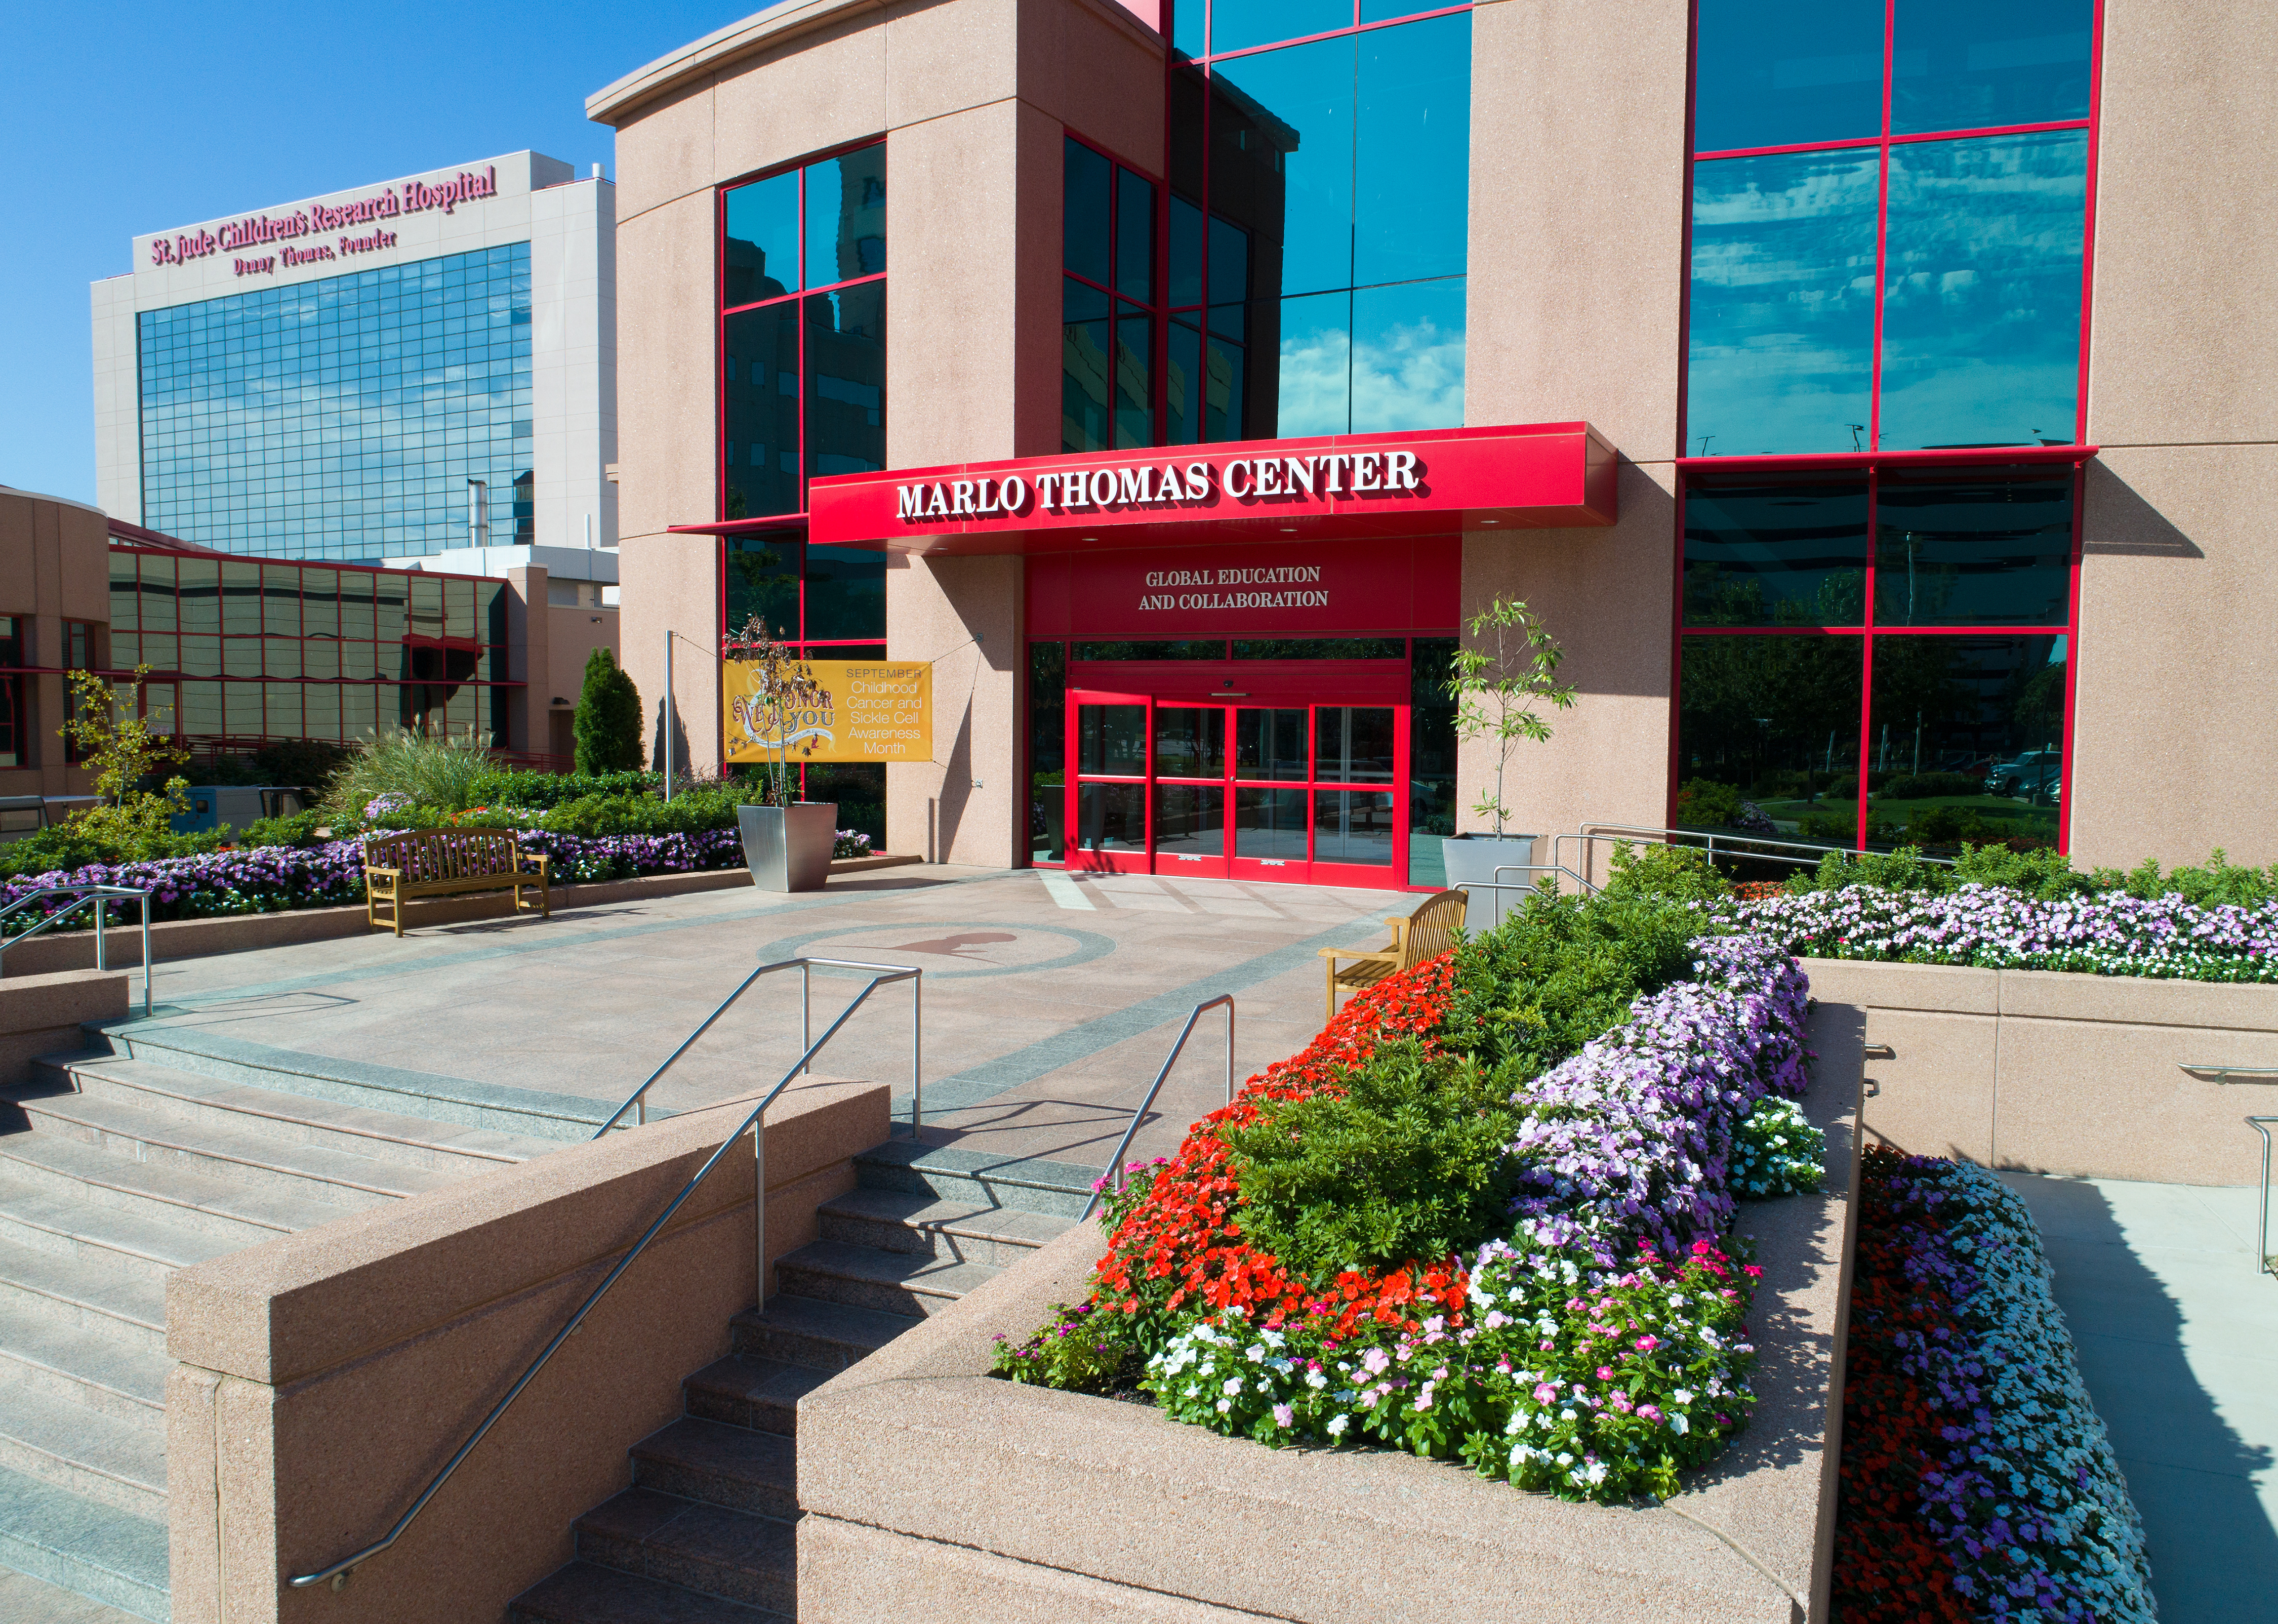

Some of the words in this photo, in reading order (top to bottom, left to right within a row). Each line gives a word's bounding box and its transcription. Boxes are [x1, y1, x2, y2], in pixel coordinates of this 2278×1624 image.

[152, 238, 171, 264] St.
[174, 229, 214, 265] Jude
[216, 210, 307, 250] Children's
[308, 187, 398, 231] Research
[400, 165, 494, 213] Hospital
[233, 256, 274, 275] Danny
[279, 246, 335, 266] Thomas,
[338, 227, 395, 254] Founder
[896, 476, 1026, 518] MARLO
[1036, 462, 1210, 508] THOMAS
[1223, 451, 1419, 498] CENTER
[1146, 570, 1214, 587] GLOBAL
[1217, 566, 1321, 584] EDUCATION
[1138, 595, 1175, 610] AND
[1178, 591, 1329, 609] COLLABORATION
[846, 668, 922, 678] SEPTEMBER
[851, 681, 917, 694] Childhood
[846, 696, 894, 709] Cancer
[898, 697, 922, 709] and
[784, 710, 835, 734] YOU
[850, 711, 889, 723] Sickle
[894, 711, 918, 723] Cell
[848, 726, 921, 739] Awareness
[864, 742, 906, 754] Month
